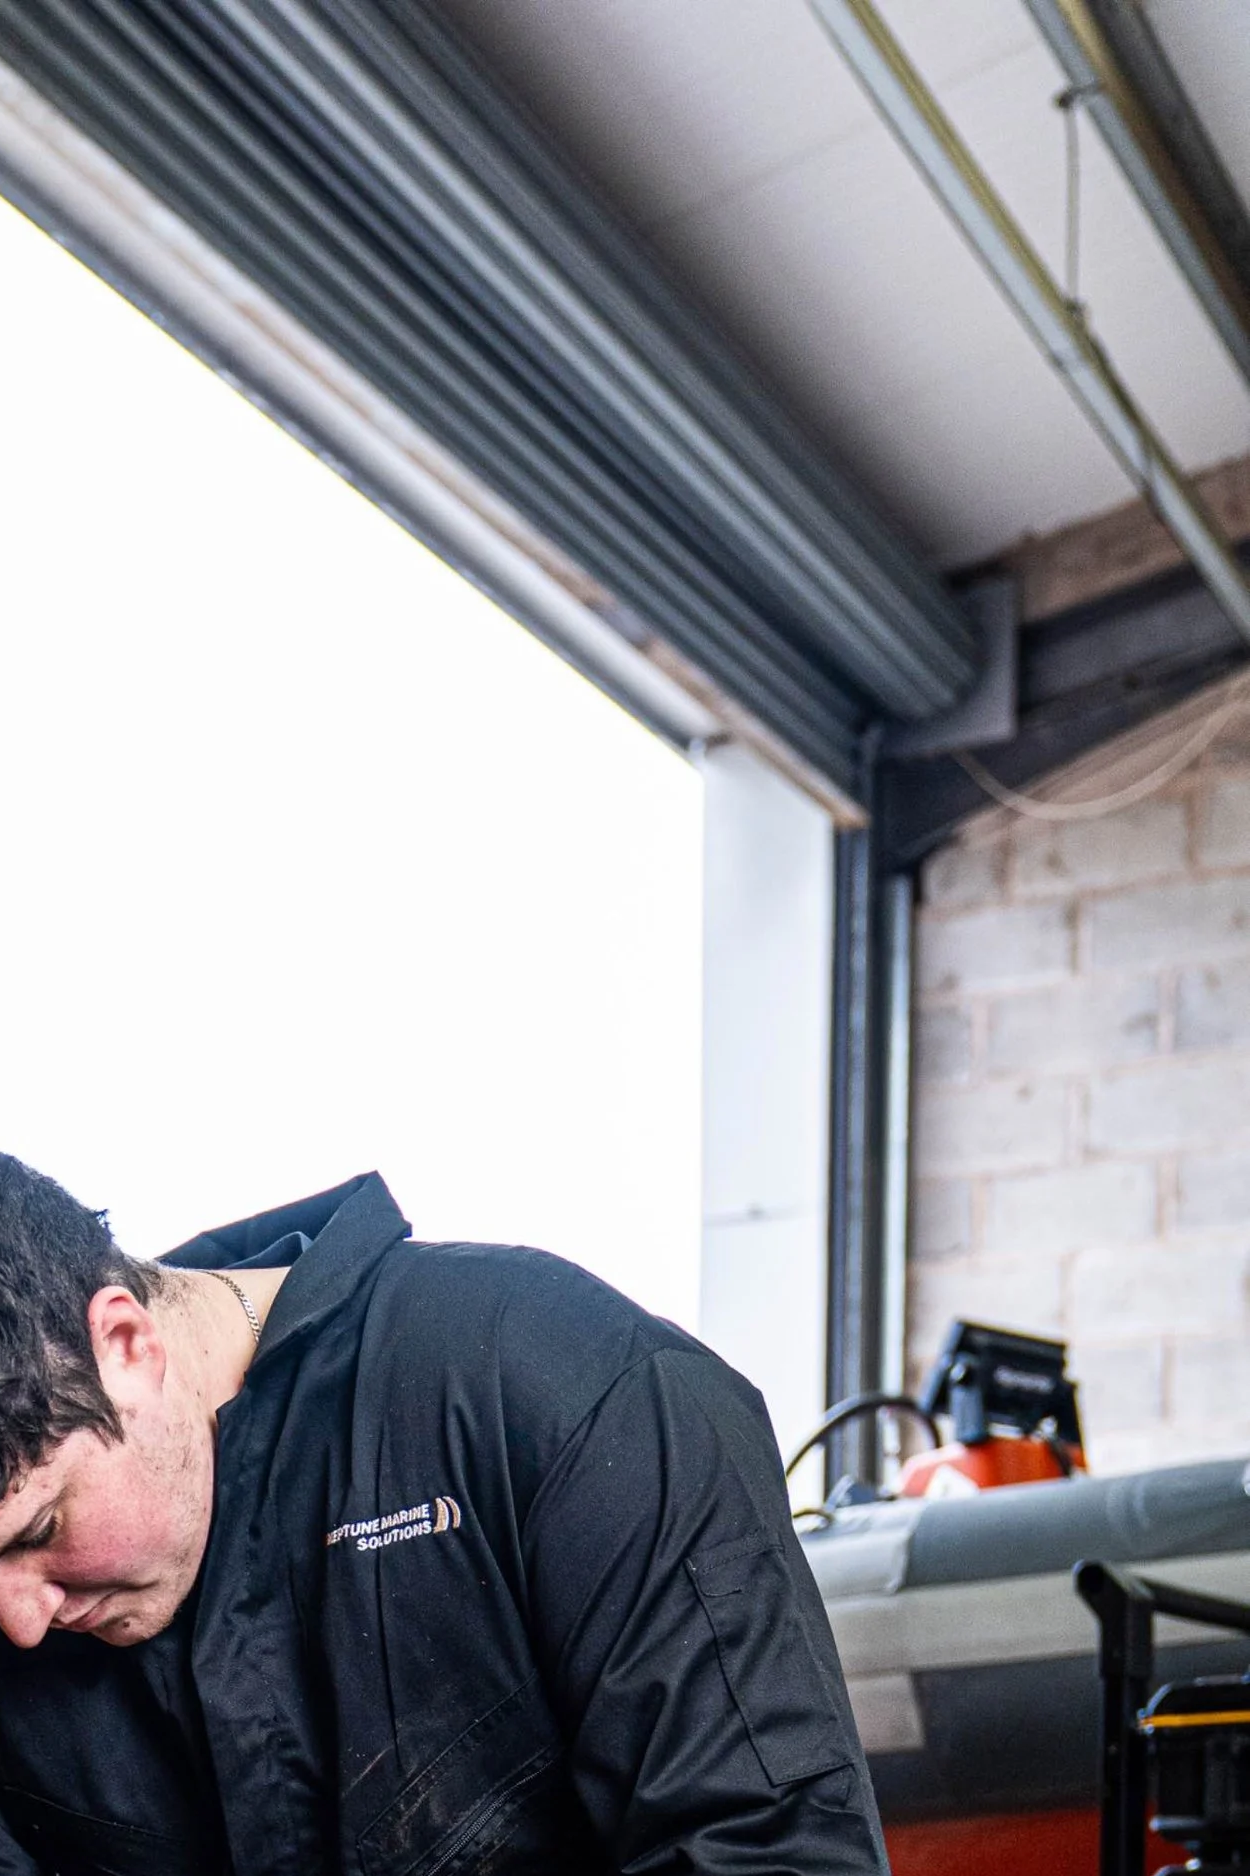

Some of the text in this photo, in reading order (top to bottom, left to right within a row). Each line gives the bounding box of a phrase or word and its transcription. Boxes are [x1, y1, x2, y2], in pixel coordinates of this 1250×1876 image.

[326, 1503, 430, 1546] NEPTUNE MARINE
[356, 1520, 432, 1551] SOLUTIONS
